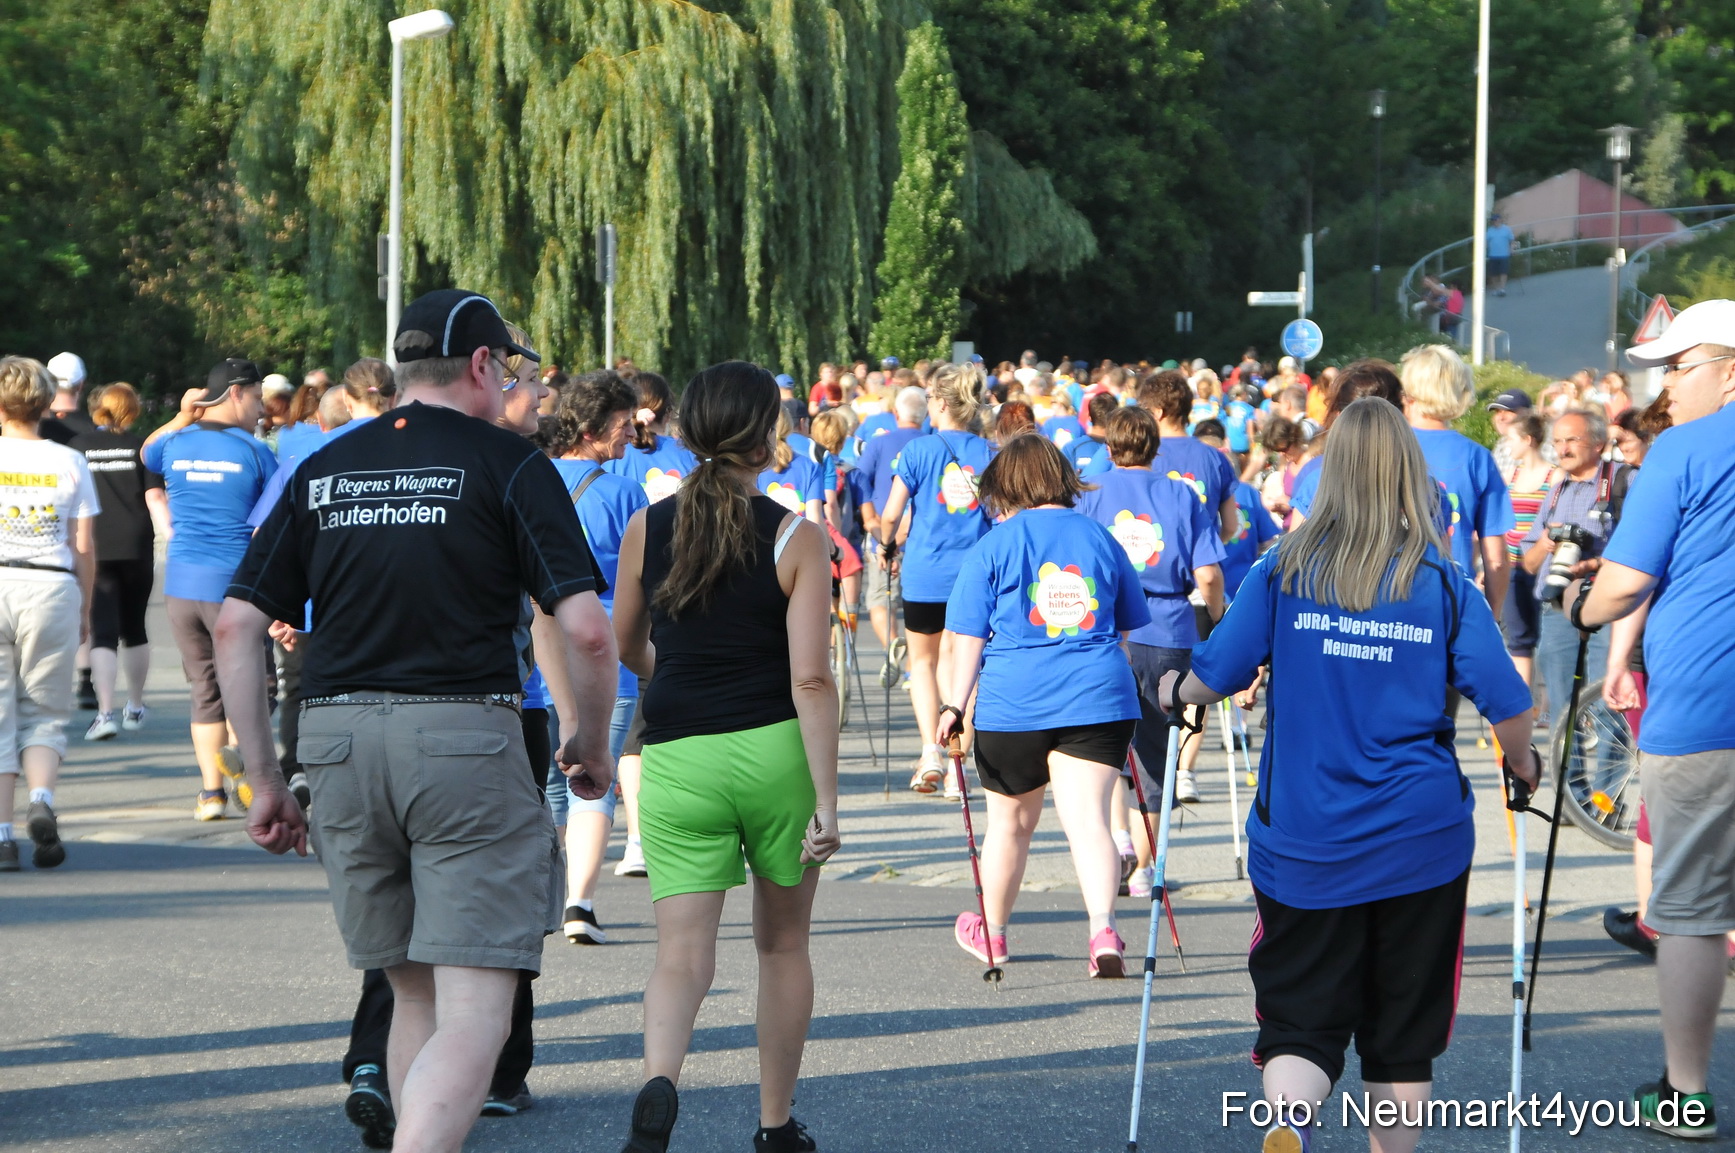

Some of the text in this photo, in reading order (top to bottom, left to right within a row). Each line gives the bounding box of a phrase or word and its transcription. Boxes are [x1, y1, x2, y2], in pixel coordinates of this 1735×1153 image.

[0, 474, 52, 486] NLINE
[334, 474, 457, 497] Regens Wagner
[317, 501, 446, 531] Lauterhofen
[1048, 591, 1081, 599] Lebens
[1048, 600, 1070, 609] hilfe
[1293, 612, 1433, 644] JURA-Werkstätten
[1322, 638, 1394, 662] Neumarkt
